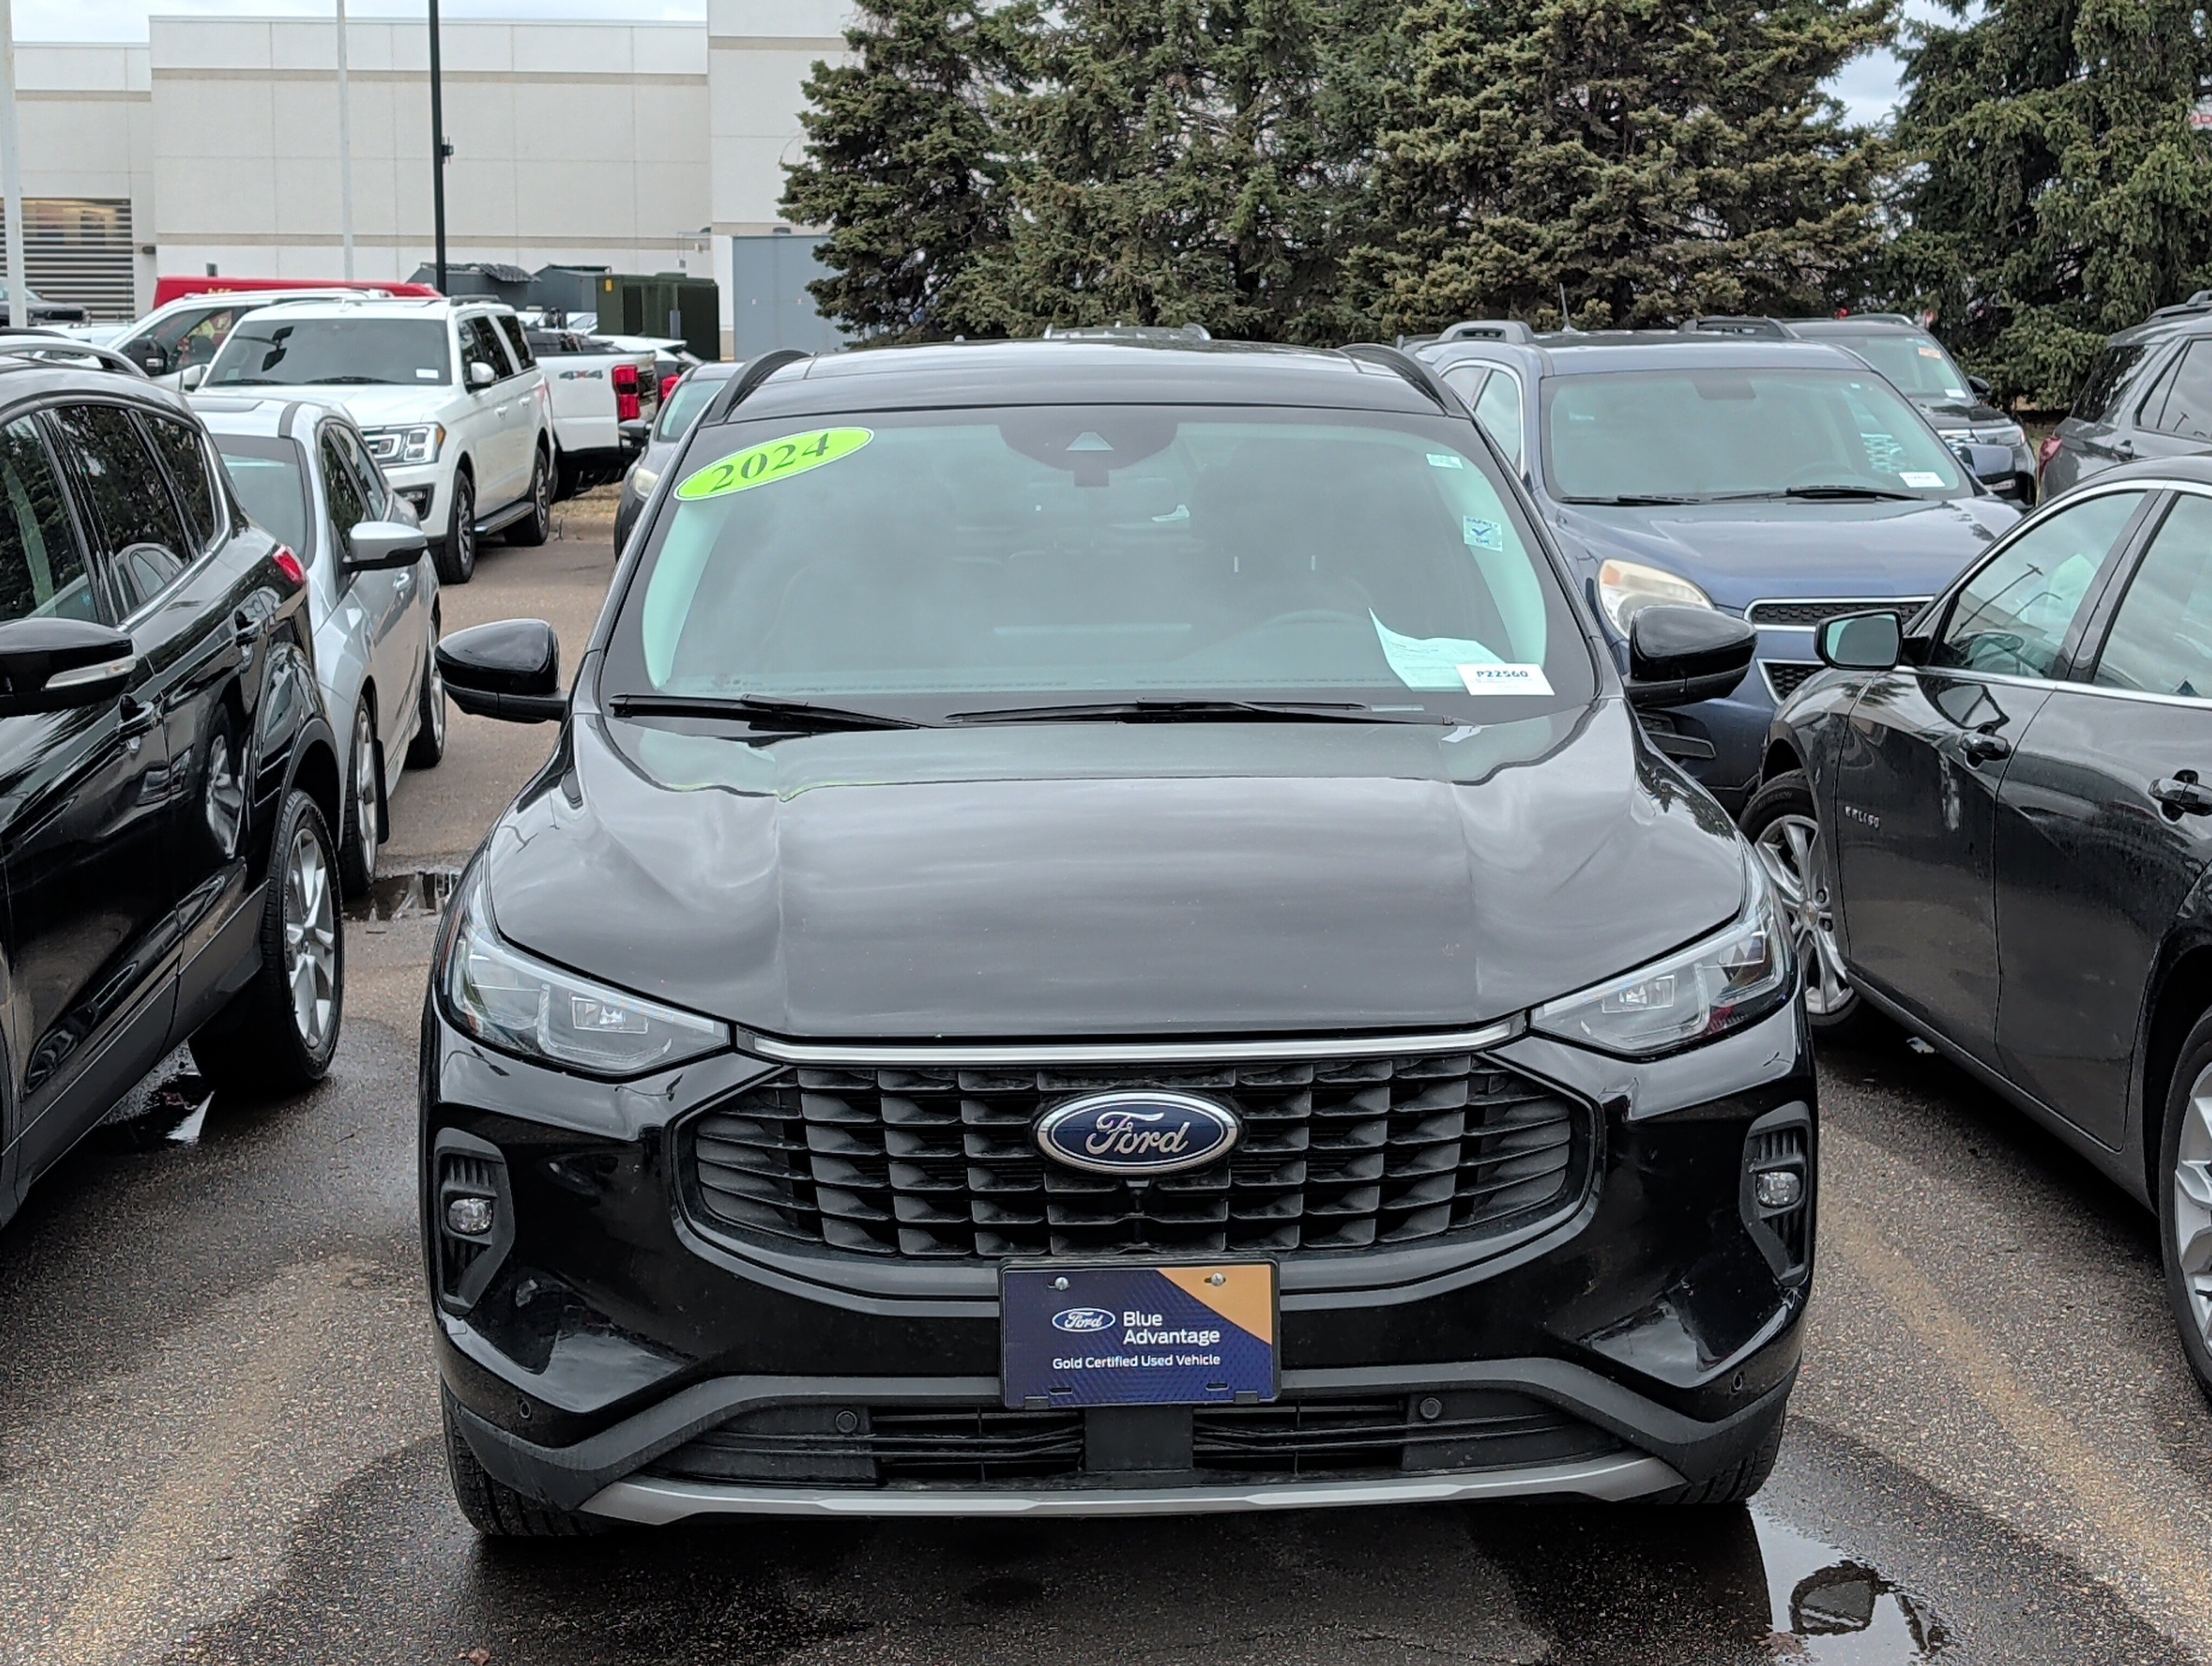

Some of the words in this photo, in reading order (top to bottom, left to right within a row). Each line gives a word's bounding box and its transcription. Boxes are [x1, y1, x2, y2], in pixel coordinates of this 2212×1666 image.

[708, 432, 829, 492] 2024
[1085, 1111, 1191, 1155] Ford
[1064, 1311, 1104, 1329] Ford
[1123, 1310, 1163, 1328] Blue
[1122, 1329, 1220, 1347] Advantage
[1052, 1357, 1082, 1370] Gold
[1085, 1355, 1138, 1368] Certified
[1141, 1355, 1174, 1367] Used
[1175, 1354, 1221, 1366] Vehicle
